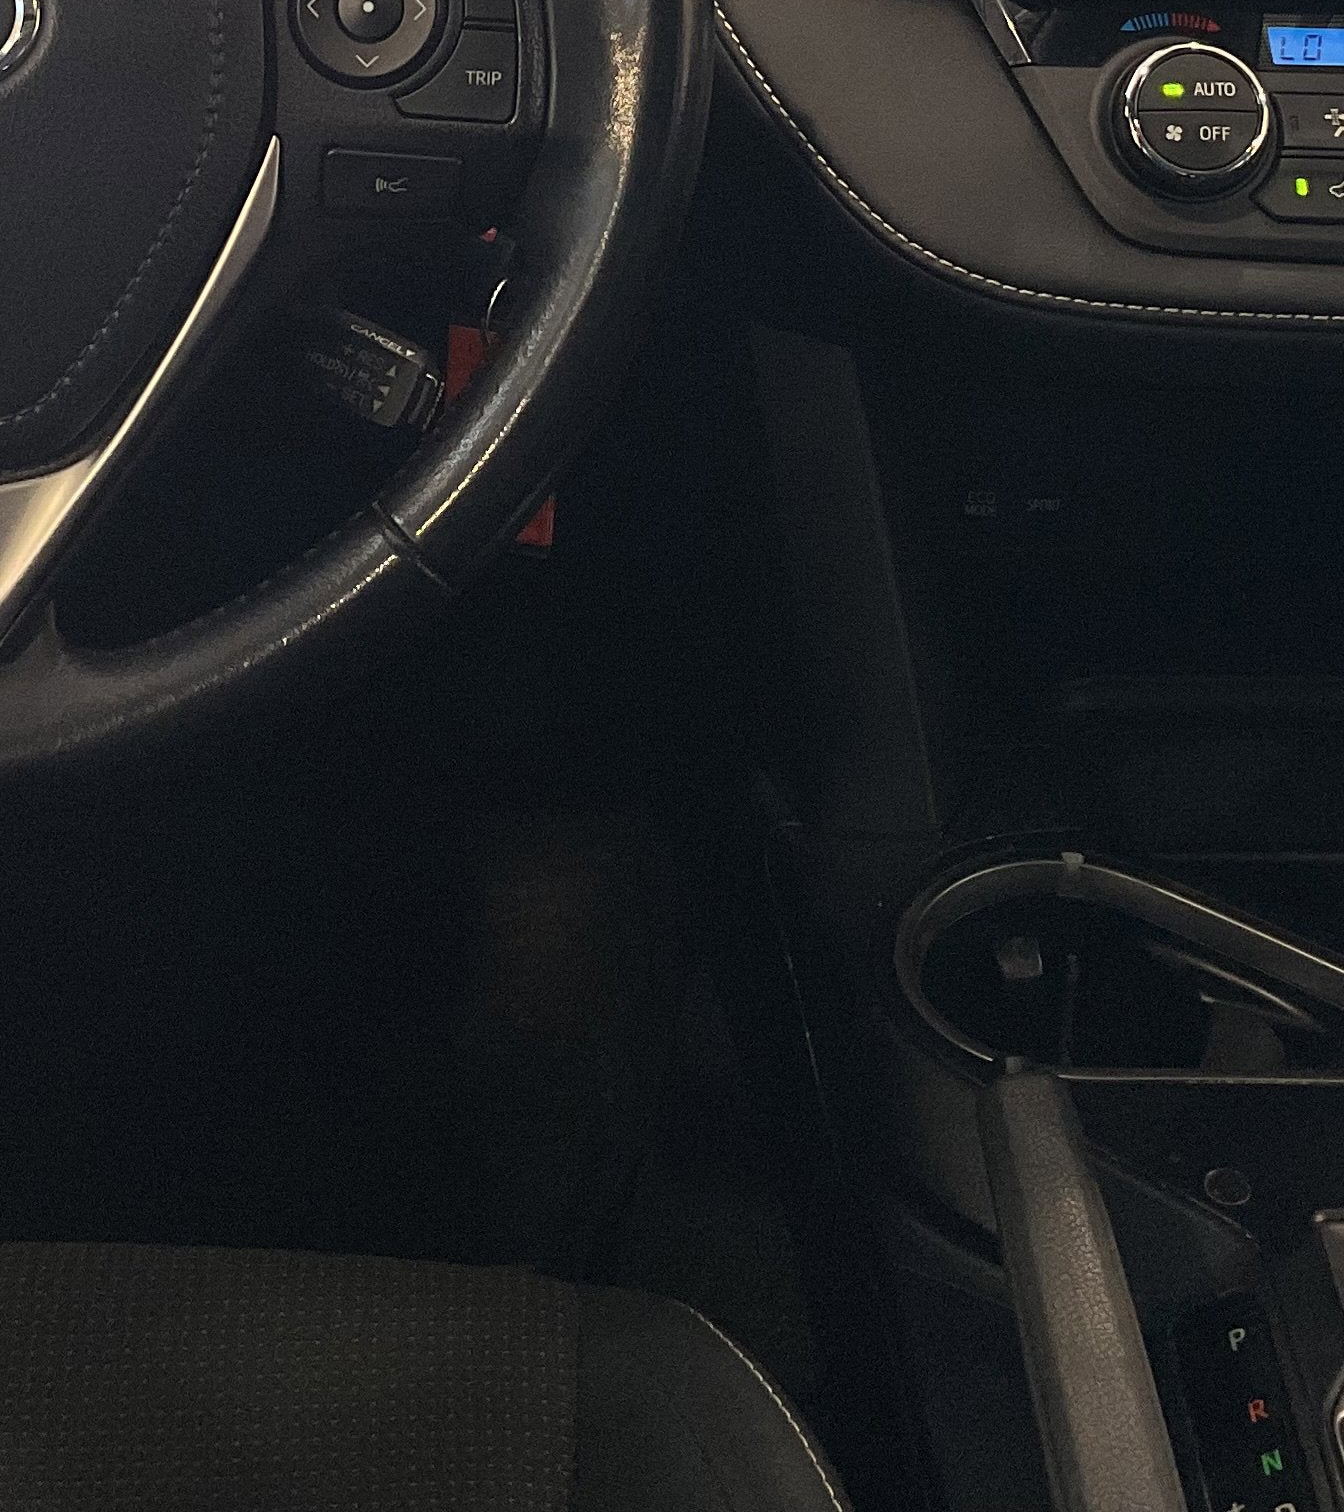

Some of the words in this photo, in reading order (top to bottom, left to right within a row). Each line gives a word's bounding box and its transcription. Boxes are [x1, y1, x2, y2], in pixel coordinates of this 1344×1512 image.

[466, 70, 502, 86] TRIP
[1193, 82, 1236, 97] AUTO
[1199, 126, 1231, 142] OFF
[351, 324, 406, 355] CANCEL
[1228, 1328, 1246, 1351] P
[1248, 1399, 1270, 1423] R
[1261, 1449, 1283, 1476] N
